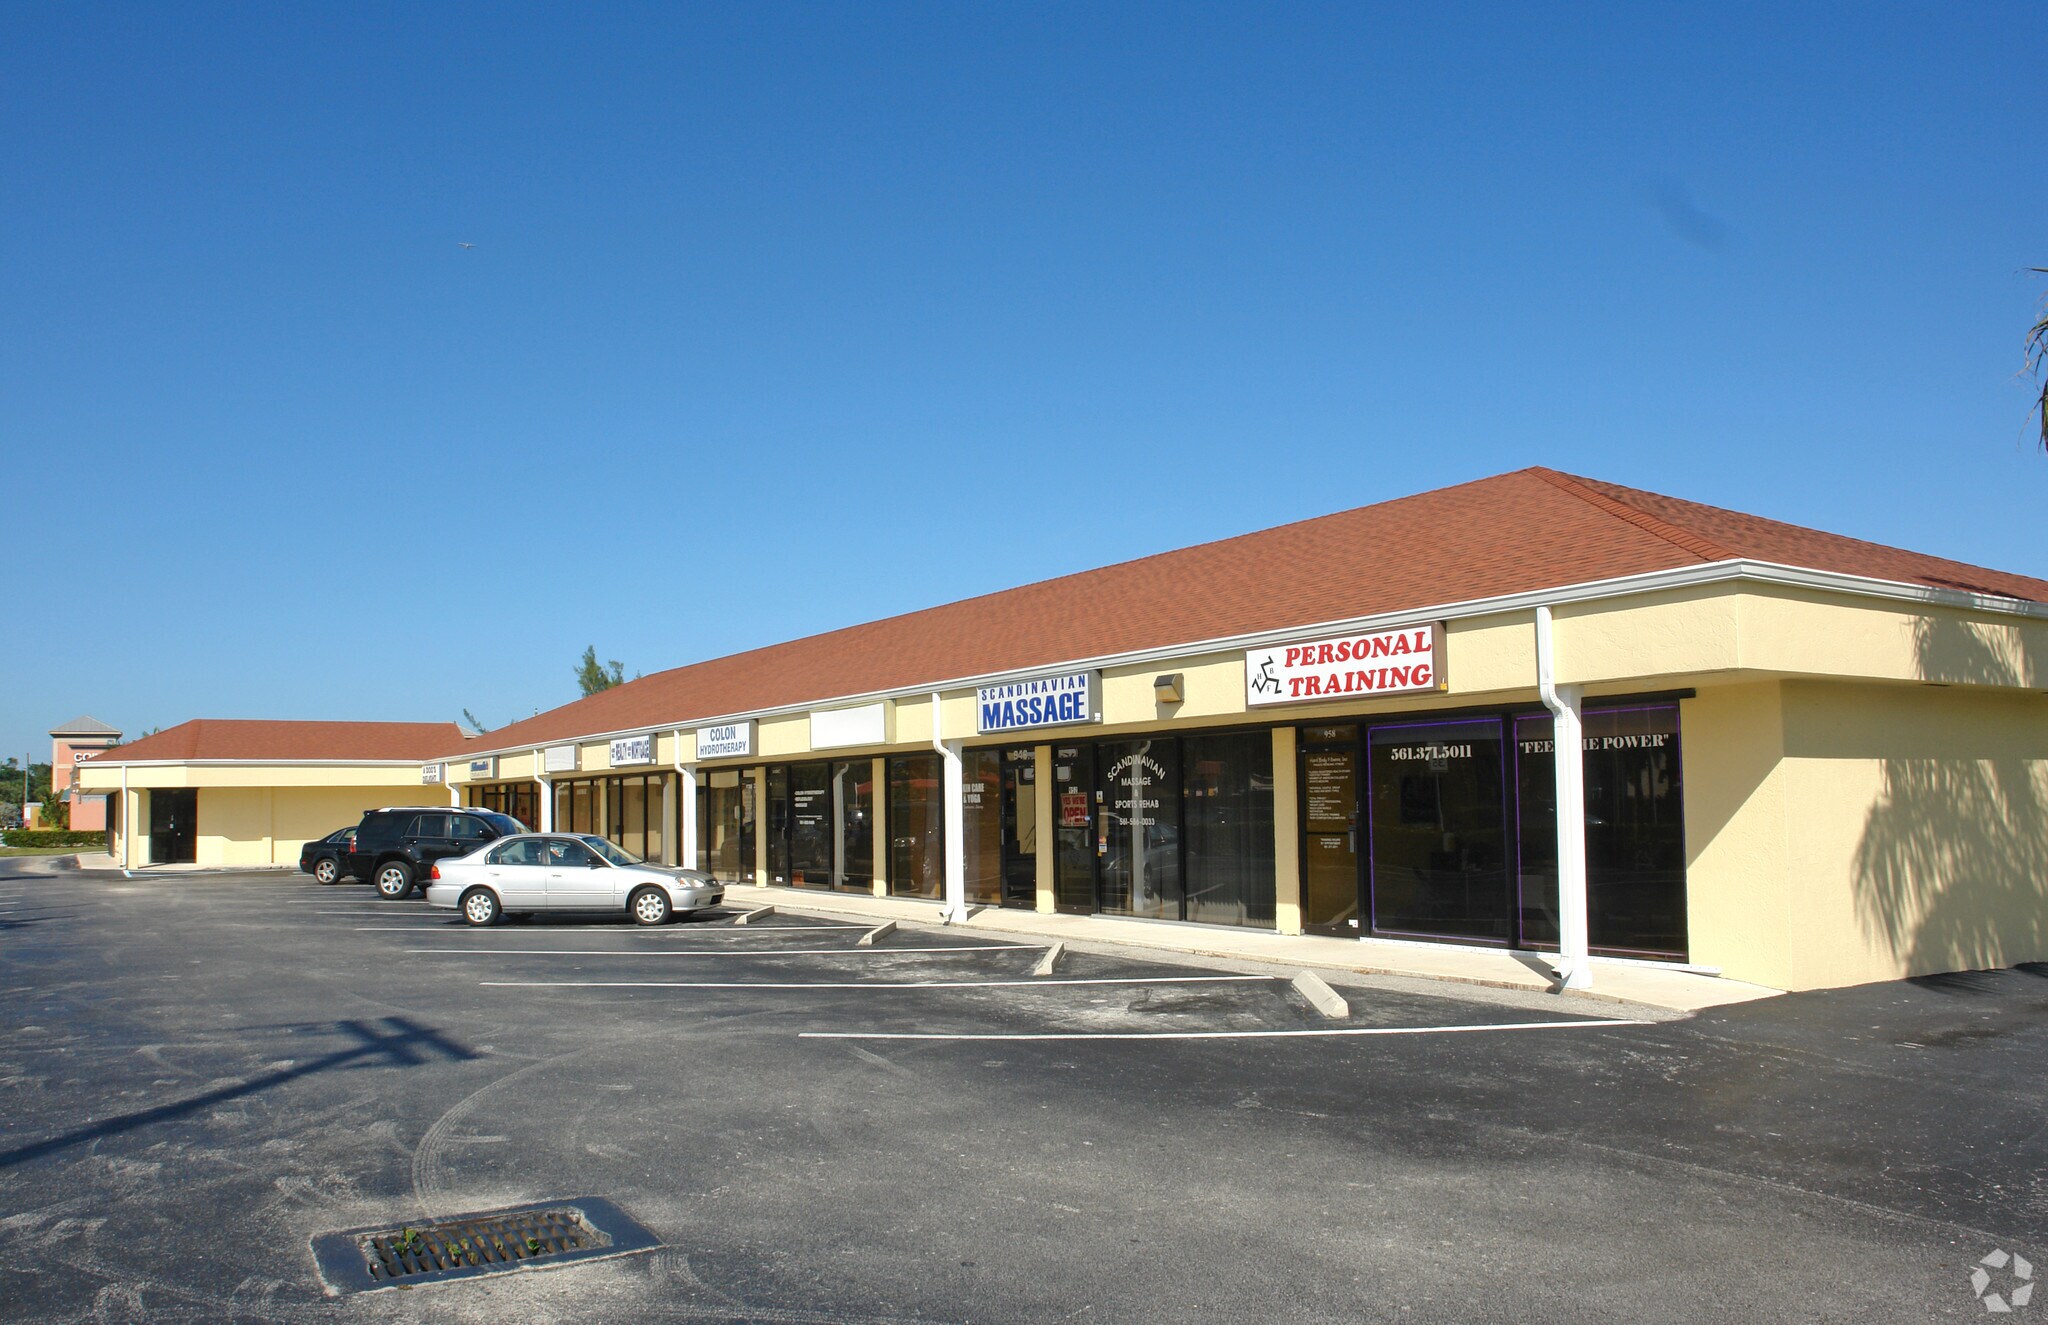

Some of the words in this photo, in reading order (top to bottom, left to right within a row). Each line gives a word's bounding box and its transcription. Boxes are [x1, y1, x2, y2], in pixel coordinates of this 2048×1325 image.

[1284, 631, 1432, 667] PERSONAL
[981, 675, 1085, 701] SCANDINAVIAN
[1288, 664, 1432, 697] TRAINING
[982, 690, 1085, 729] MASSAGE
[710, 726, 736, 741] COLON
[700, 740, 746, 755] HYDROTHERAPY
[1391, 745, 1472, 761] 561.371.5011
[1107, 755, 1166, 782] SCANDINAVIAN
[1121, 777, 1152, 786] MASSAGE
[1115, 800, 1137, 808] SPORTS
[1139, 800, 1159, 808] REHAB
[1064, 806, 1086, 822] OPEN
